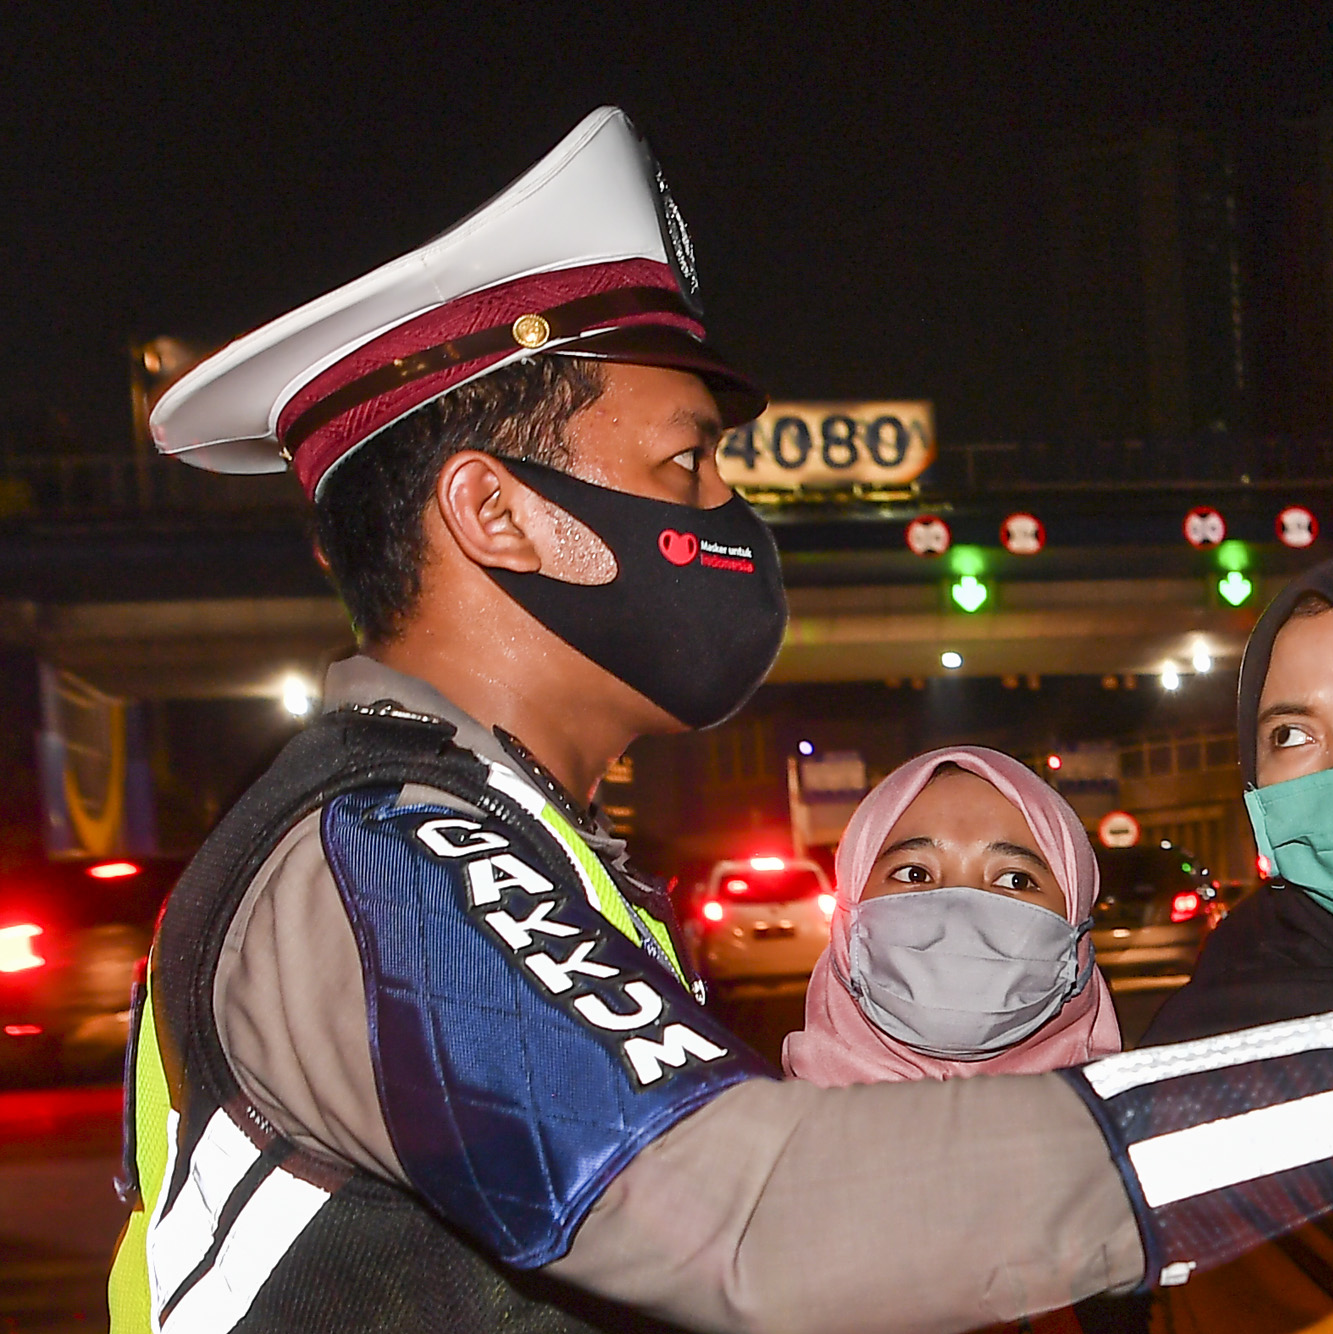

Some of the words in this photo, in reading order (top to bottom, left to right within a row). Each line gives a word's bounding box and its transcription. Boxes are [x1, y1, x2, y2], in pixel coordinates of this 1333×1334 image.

[722, 417, 909, 469] 4080
[700, 540, 727, 554] Masker
[728, 546, 753, 558] untuk
[415, 818, 729, 1086] GAKKUM
